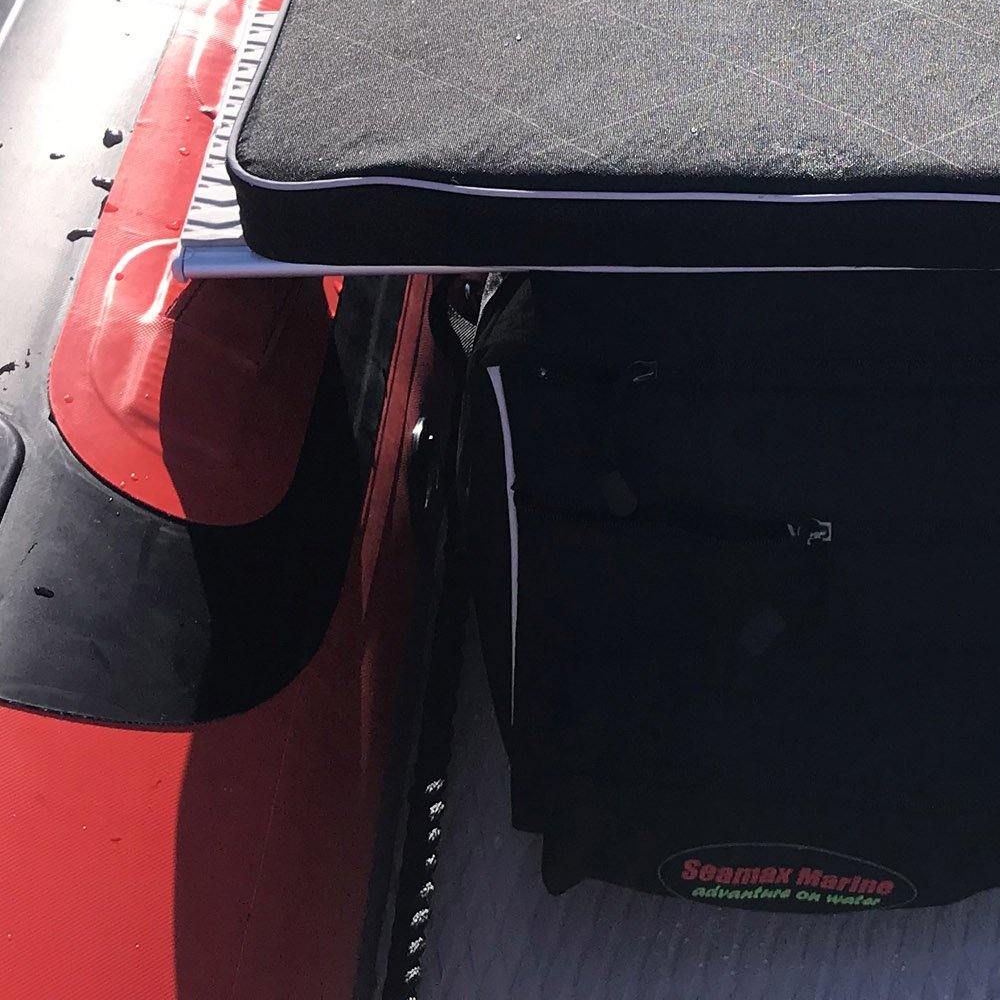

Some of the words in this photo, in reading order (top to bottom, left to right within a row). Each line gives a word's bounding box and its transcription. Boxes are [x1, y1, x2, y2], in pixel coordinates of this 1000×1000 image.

[681, 858, 794, 885] Seamax
[796, 867, 895, 896] Marine
[795, 890, 820, 902] on
[826, 894, 882, 906] water
